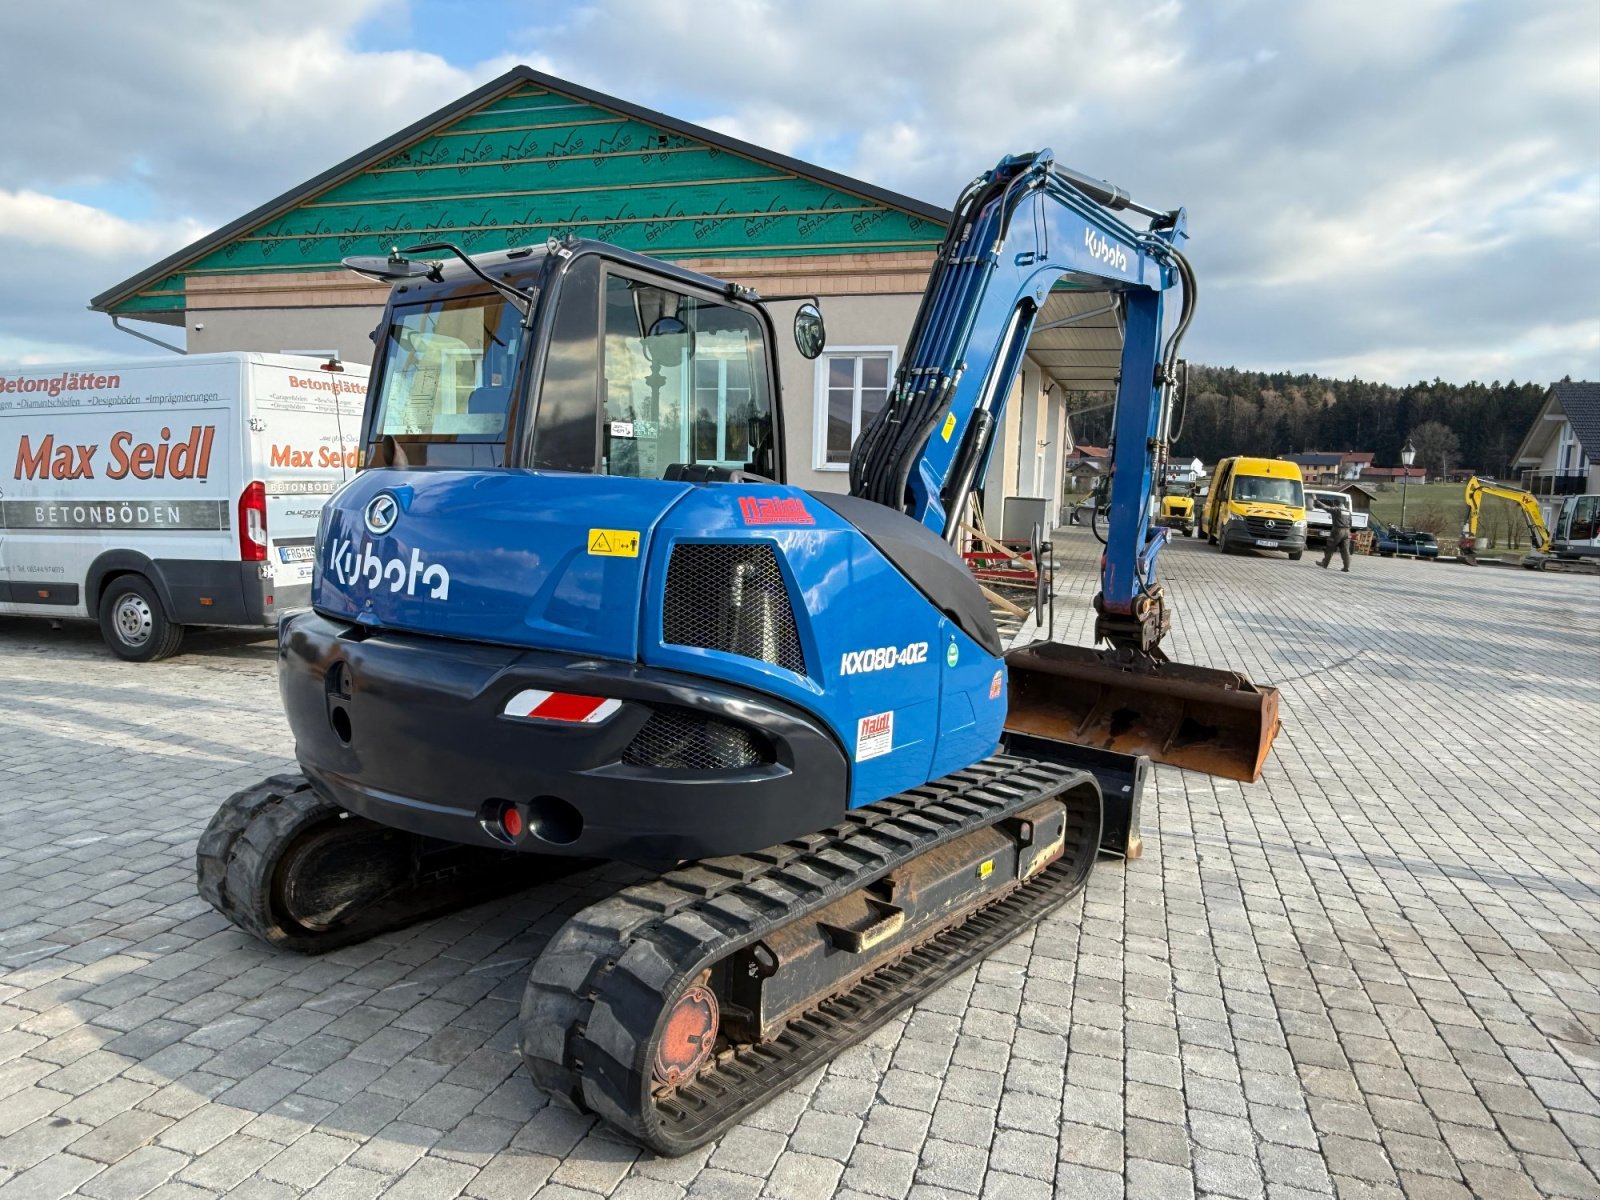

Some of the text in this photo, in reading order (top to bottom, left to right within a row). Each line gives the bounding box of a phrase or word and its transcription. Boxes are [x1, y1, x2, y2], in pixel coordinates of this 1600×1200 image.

[1085, 228, 1126, 272] Kubota
[288, 375, 370, 395] Betonglätte
[14, 425, 216, 480] Max Seidl
[270, 444, 360, 468] Max Seid
[35, 502, 181, 524] BETONBÖDEN
[330, 538, 449, 600] Kubota
